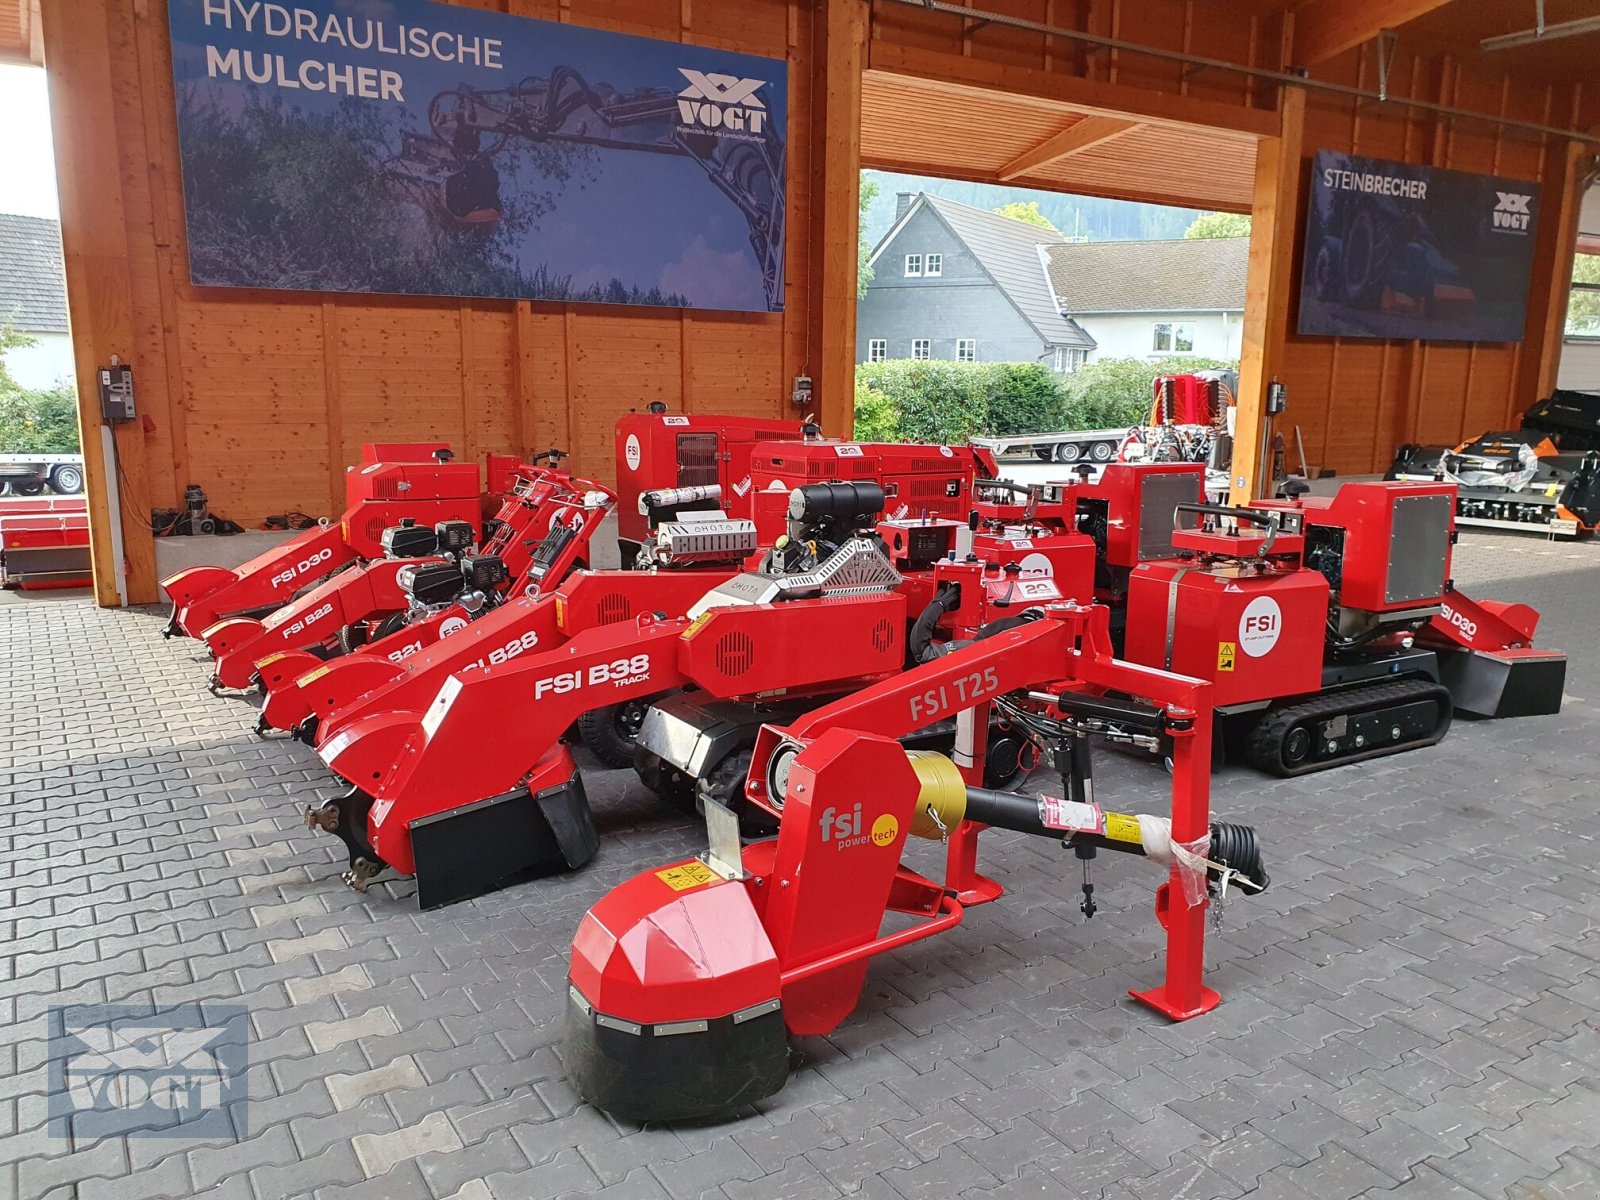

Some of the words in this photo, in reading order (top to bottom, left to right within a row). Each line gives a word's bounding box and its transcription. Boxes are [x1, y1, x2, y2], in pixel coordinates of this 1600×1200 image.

[203, 0, 503, 69] HYDRAULISCHE
[206, 45, 405, 102] MULCHER
[677, 100, 766, 133] VOGT
[1323, 168, 1427, 200] STEINBRECHER
[1493, 211, 1530, 230] VOGT
[271, 567, 297, 588] FSI
[282, 620, 305, 639] FSI
[304, 603, 333, 625] B22
[1245, 614, 1276, 634] FSI
[1440, 602, 1454, 621] SI
[1451, 612, 1477, 636] D30
[488, 630, 539, 666] B28
[535, 670, 582, 700] FSI
[588, 654, 650, 686] B38
[614, 672, 650, 688] TRACK
[909, 686, 948, 721] FSI
[953, 666, 999, 703] T25
[819, 802, 862, 842] fsi
